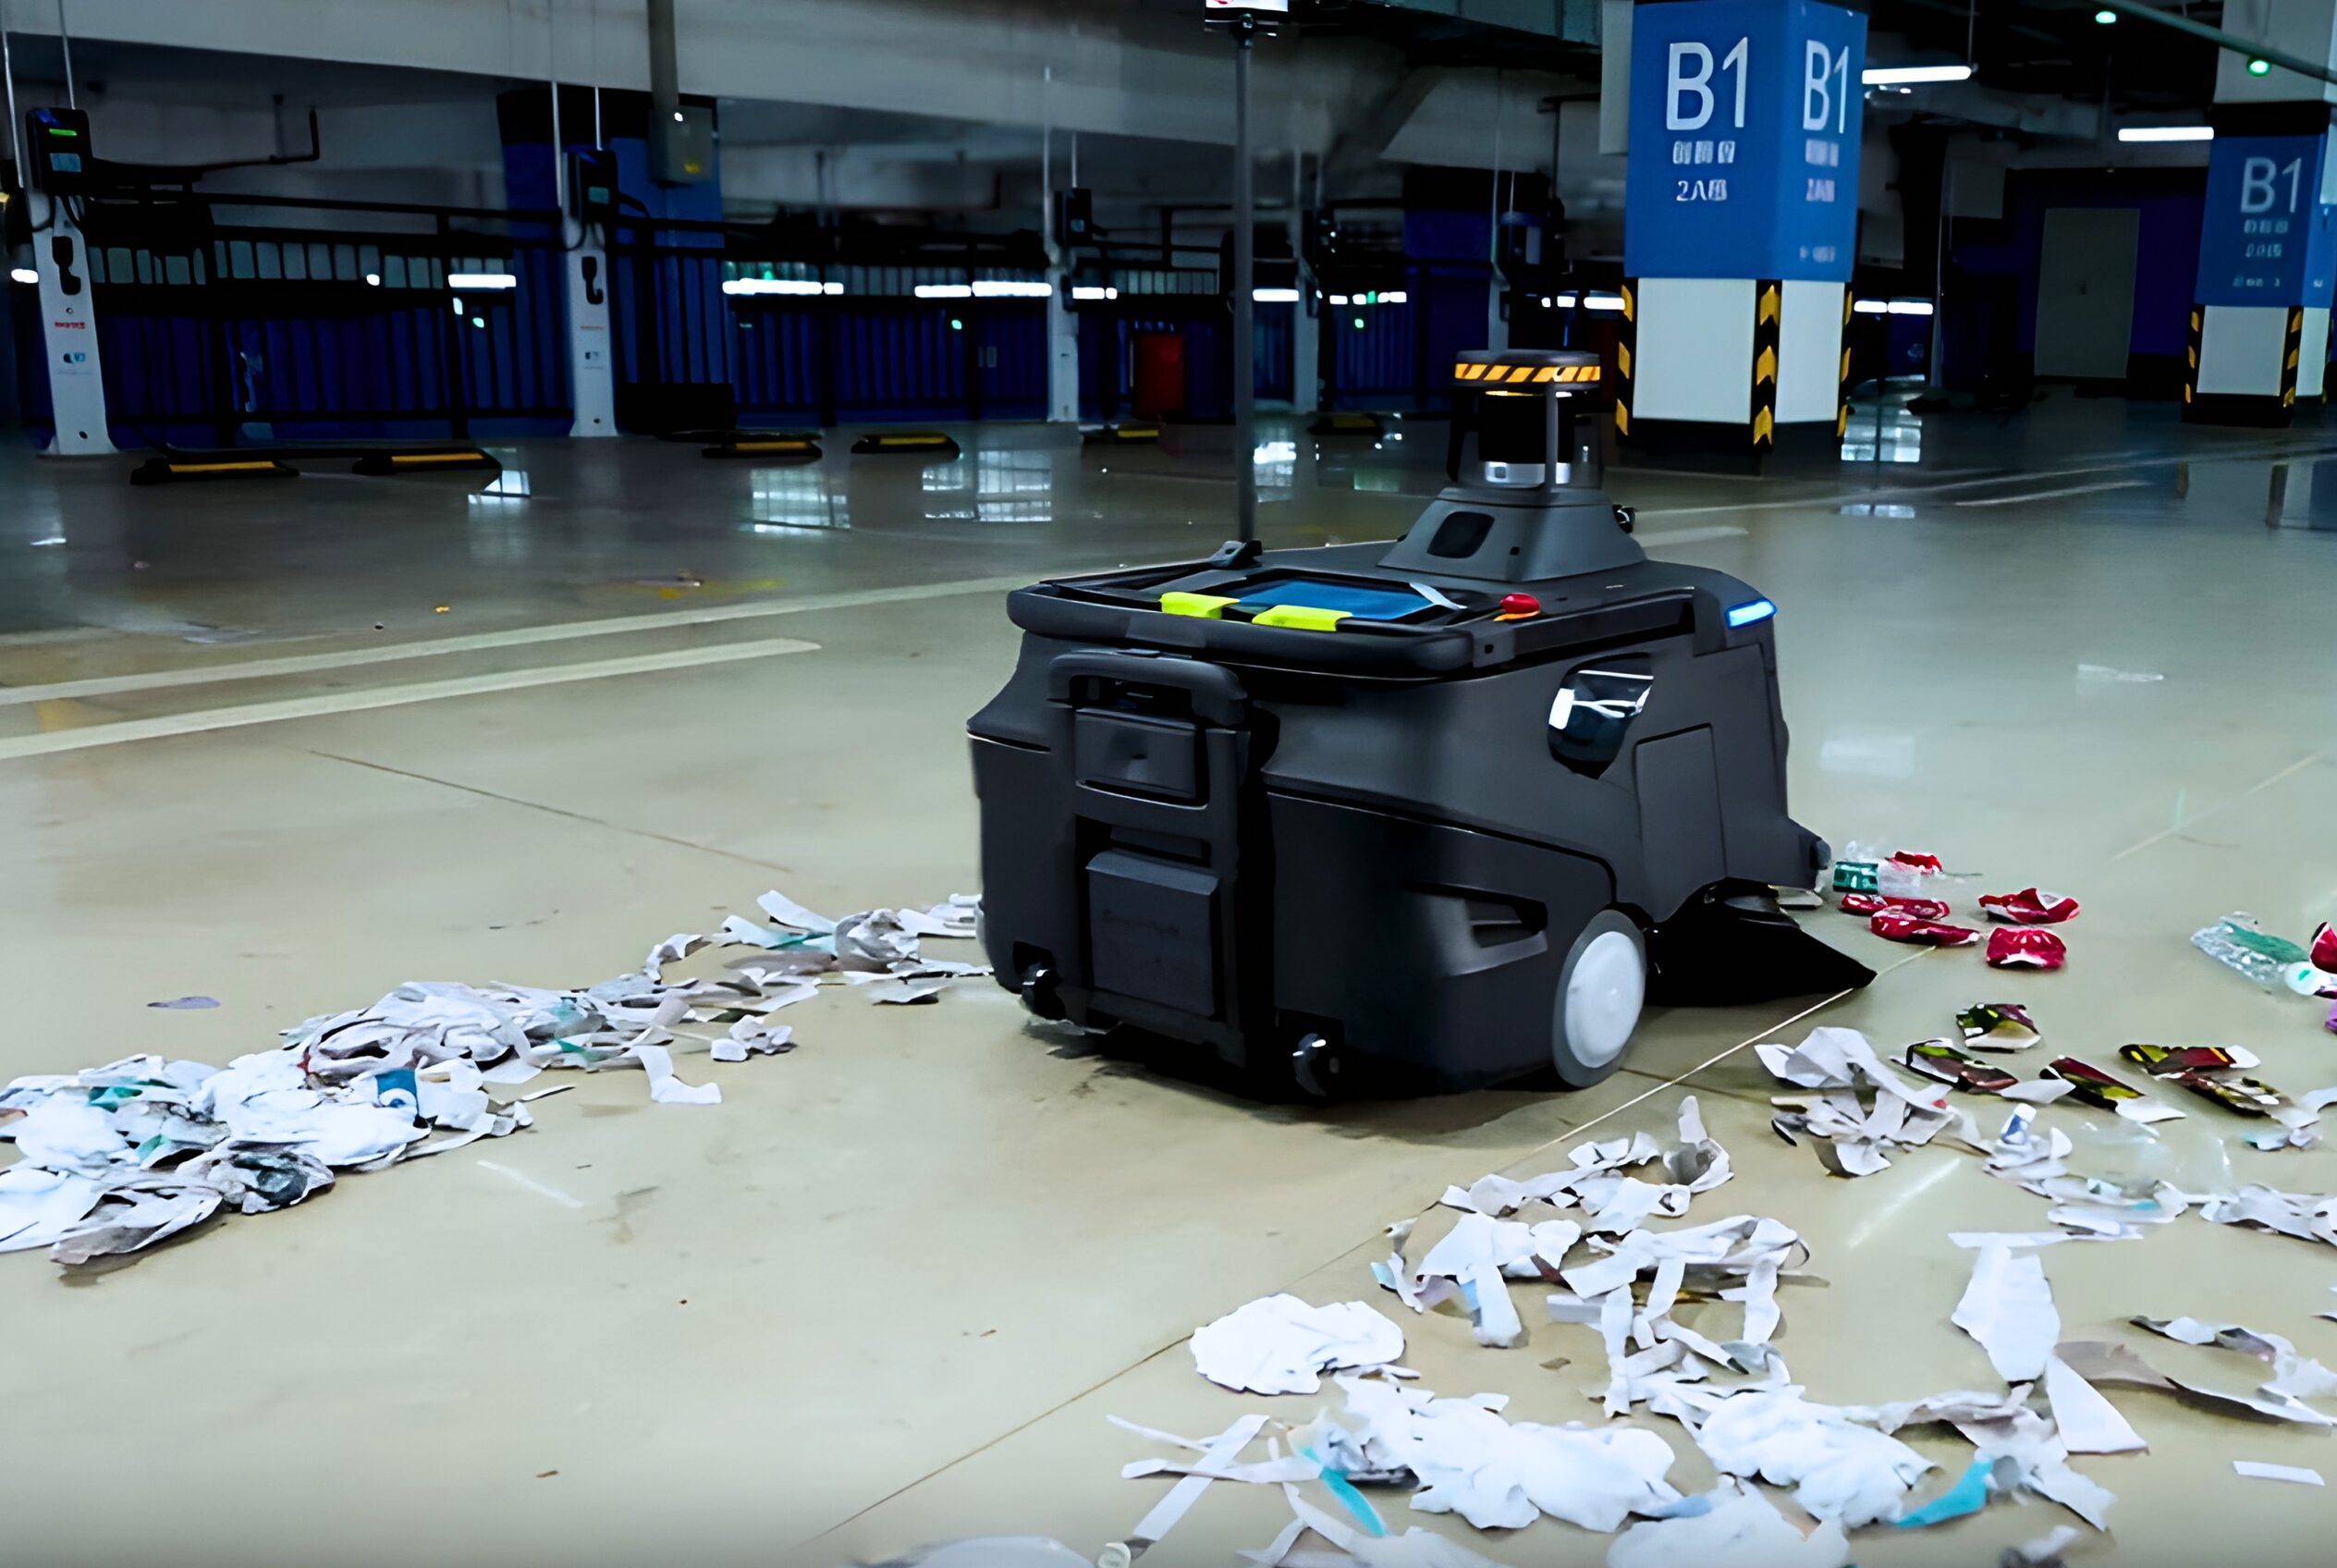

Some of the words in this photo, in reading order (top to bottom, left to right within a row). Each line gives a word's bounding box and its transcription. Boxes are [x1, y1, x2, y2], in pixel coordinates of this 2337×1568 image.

[1666, 36, 1748, 130] B1
[1803, 39, 1849, 134] B1
[2240, 157, 2302, 214] B1
